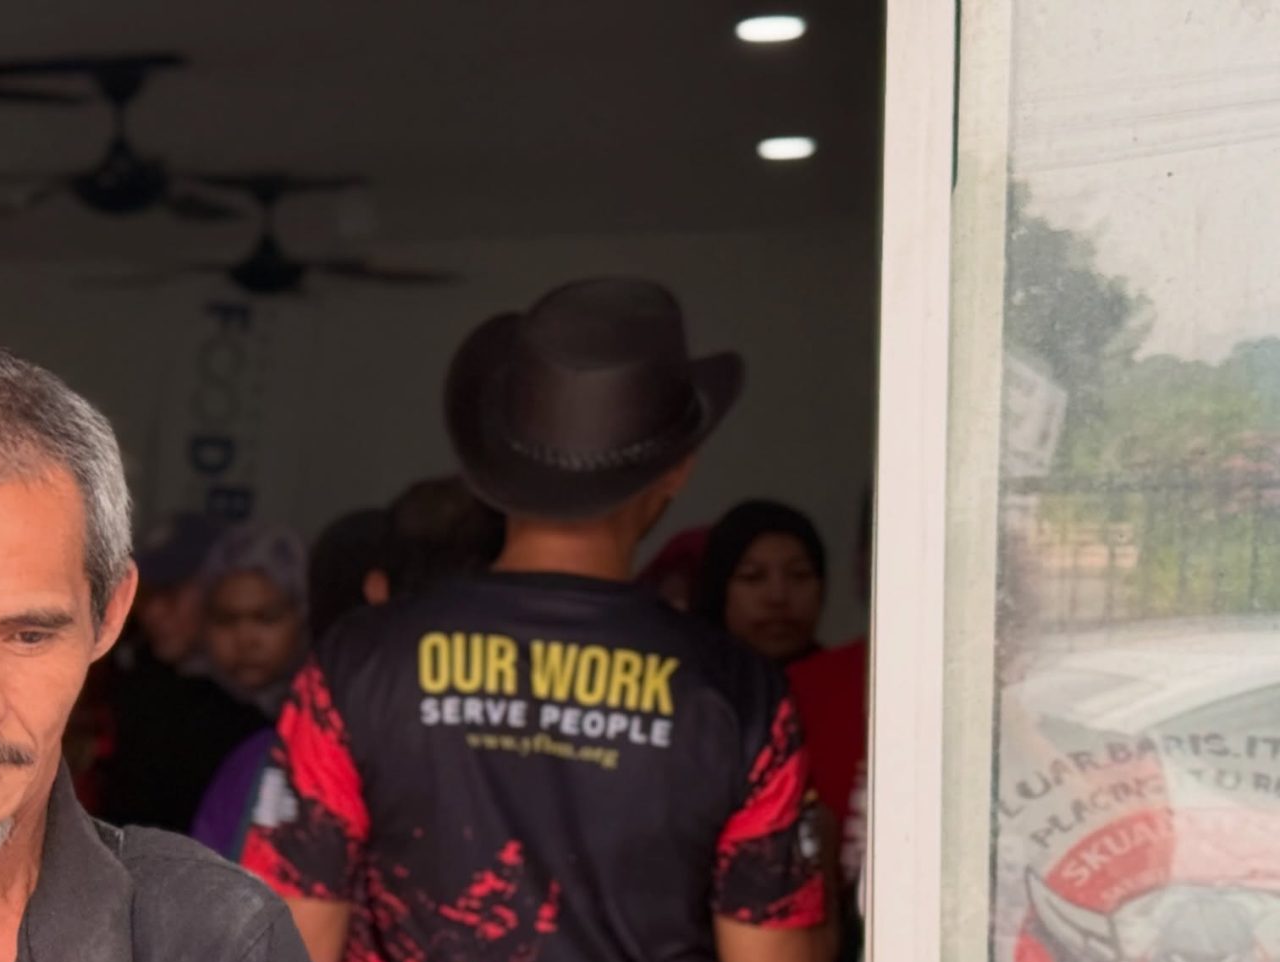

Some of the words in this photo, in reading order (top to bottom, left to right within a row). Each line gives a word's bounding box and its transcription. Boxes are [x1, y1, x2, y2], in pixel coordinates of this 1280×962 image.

[419, 632, 517, 695] OUR
[531, 639, 678, 715] WORK
[420, 696, 527, 728] SERVE
[539, 703, 672, 747] PEOPLE
